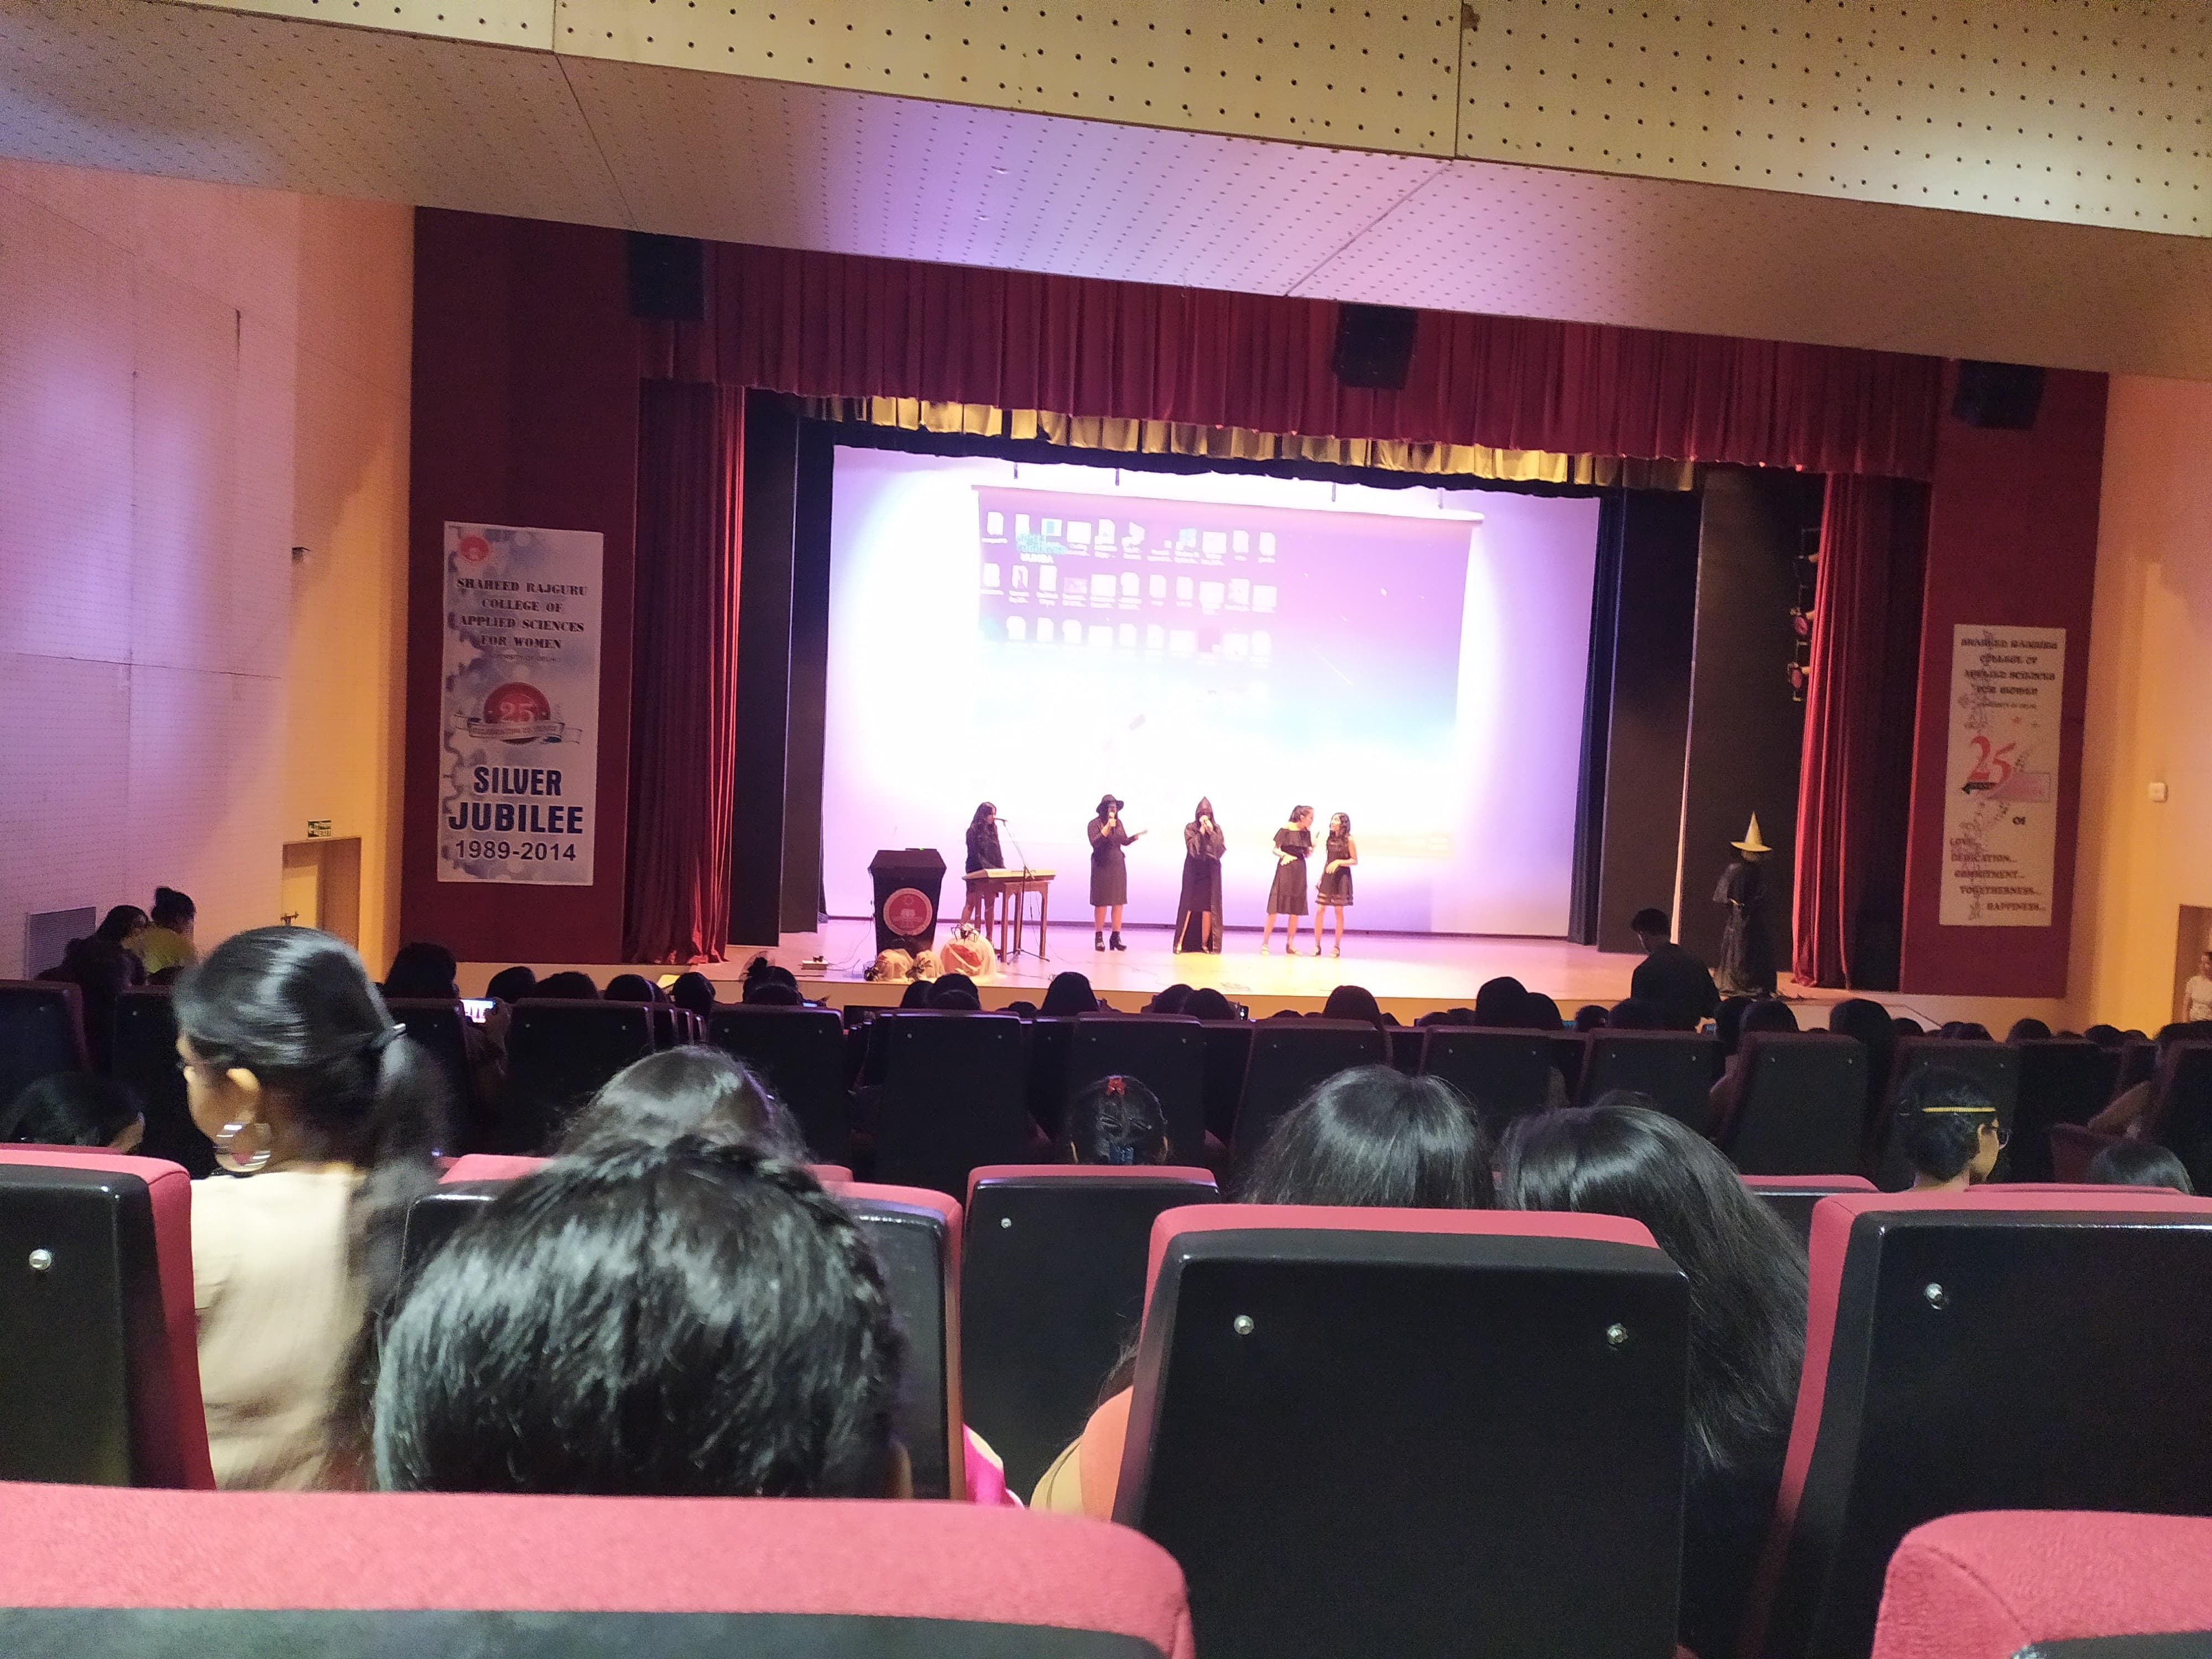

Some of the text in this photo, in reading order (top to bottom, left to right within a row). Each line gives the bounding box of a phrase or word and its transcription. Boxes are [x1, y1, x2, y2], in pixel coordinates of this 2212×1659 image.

[457, 579, 588, 596] SHAHEED RAJGURU
[482, 599, 563, 613] COLLEGE OF
[460, 615, 585, 632] APPLIED SCIENCES
[481, 635, 562, 649] FOR WOMEN
[499, 702, 535, 723] 25
[1967, 736, 2016, 786] 25
[473, 767, 561, 796] SILVER
[448, 802, 583, 834] JUBILEE
[455, 840, 576, 861] 1989-2014
